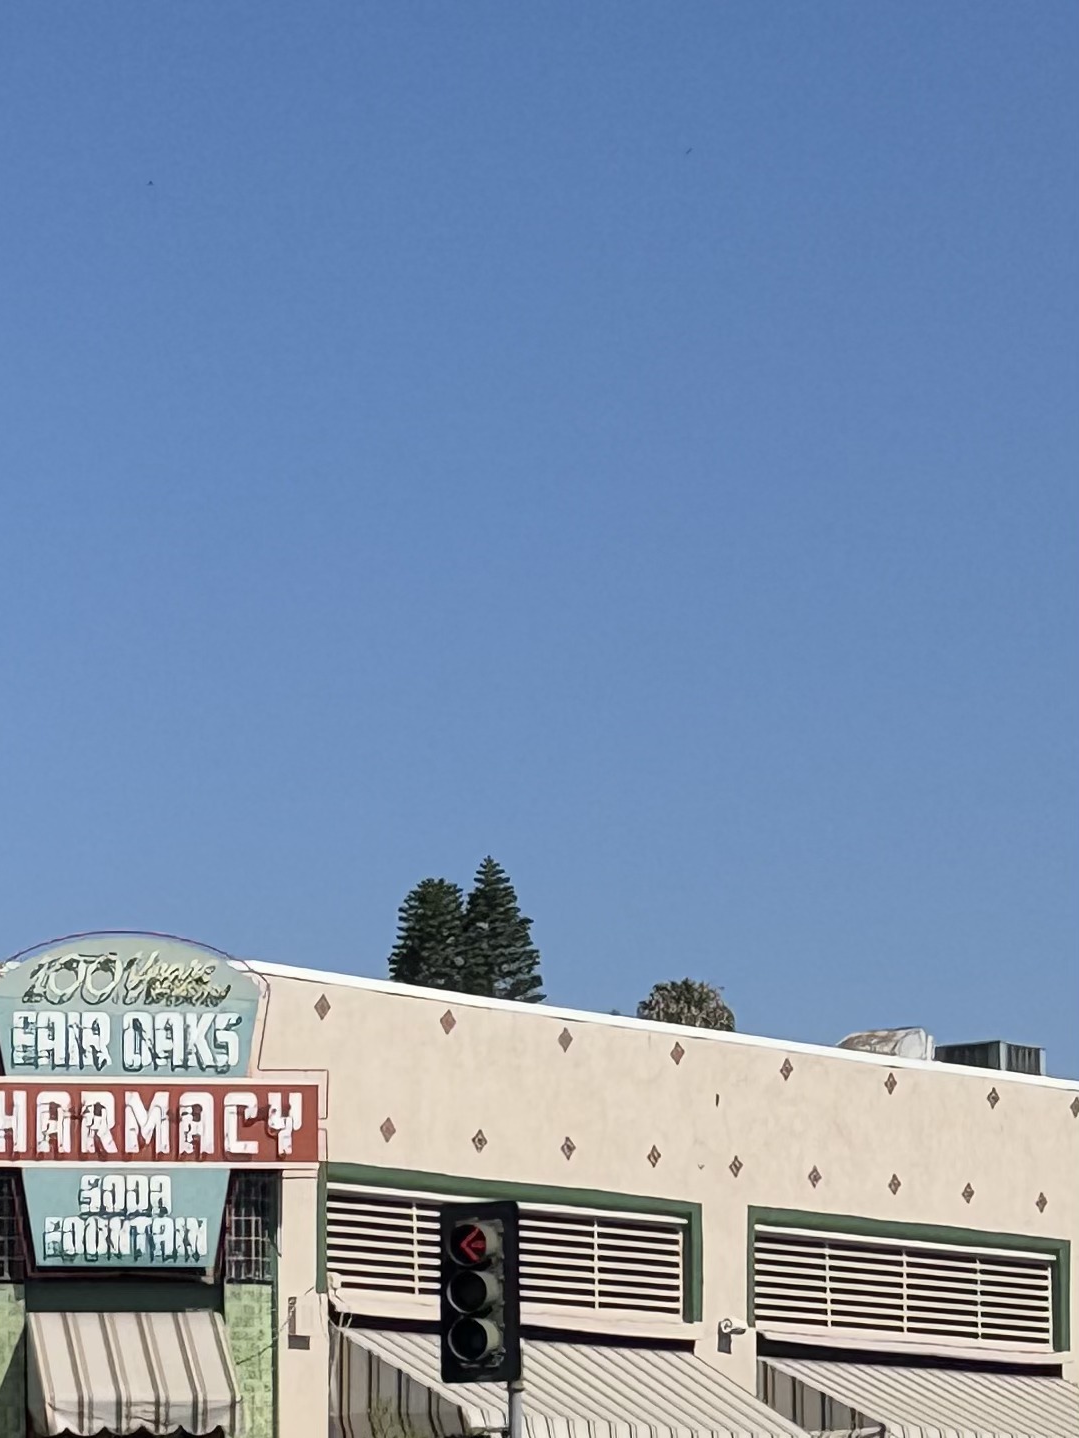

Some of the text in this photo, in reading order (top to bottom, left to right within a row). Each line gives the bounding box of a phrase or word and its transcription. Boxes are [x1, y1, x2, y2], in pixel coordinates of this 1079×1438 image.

[11, 1011, 242, 1072] FAIR OAKS
[80, 1175, 172, 1216] SODA
[44, 1216, 208, 1260] FOUNTAIN
